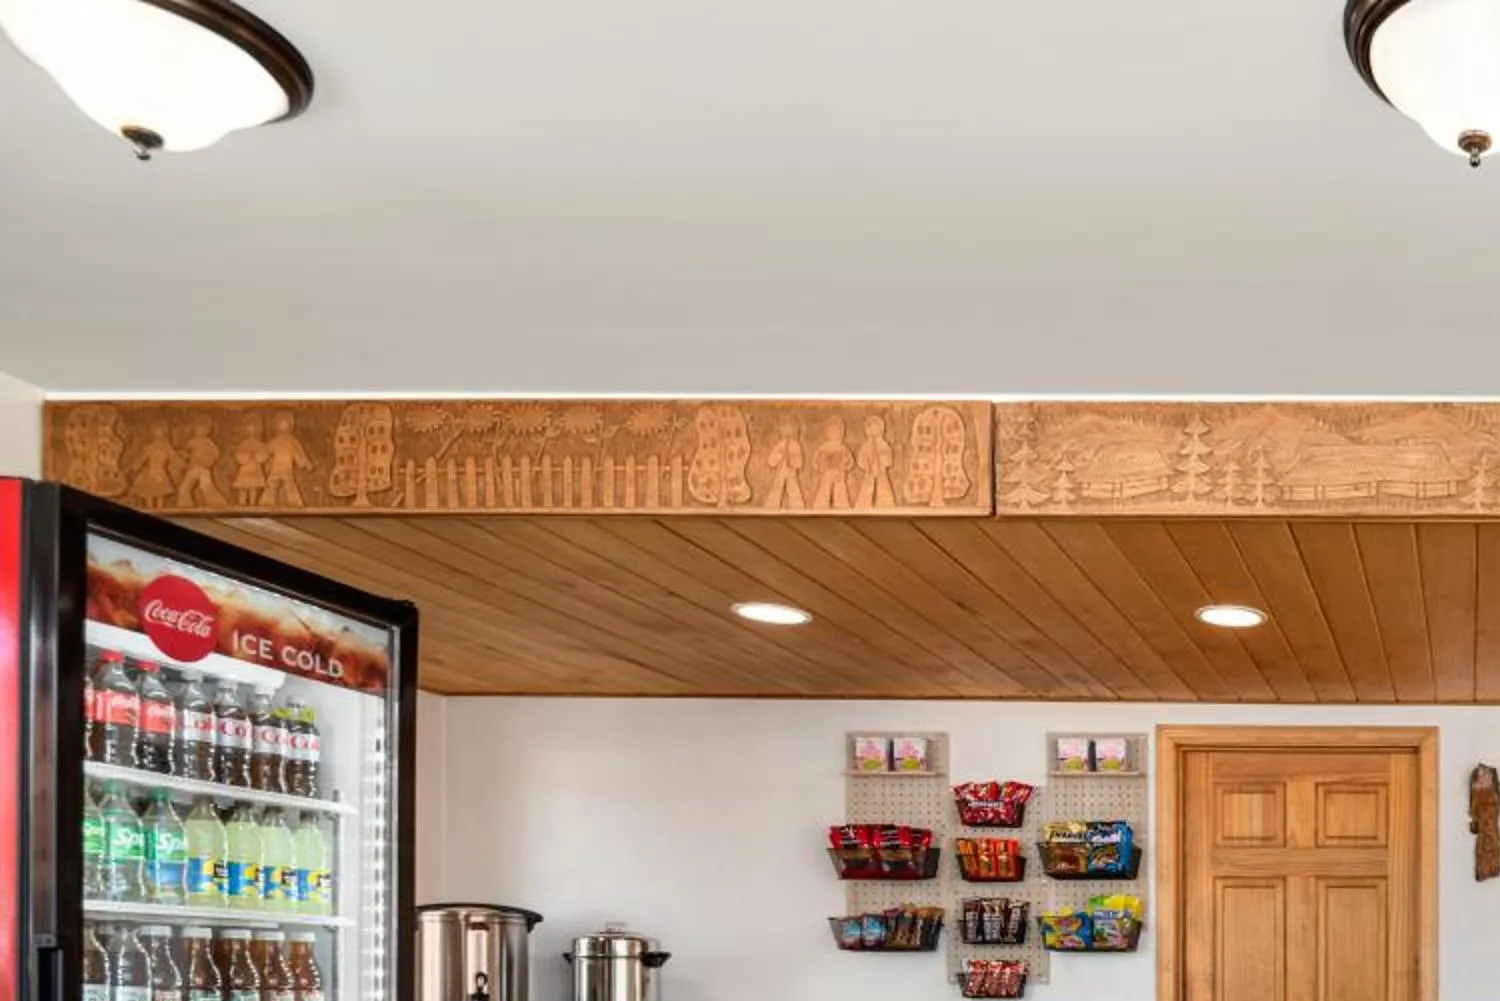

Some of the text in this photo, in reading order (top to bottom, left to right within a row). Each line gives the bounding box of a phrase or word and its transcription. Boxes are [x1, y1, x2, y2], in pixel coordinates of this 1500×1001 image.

[144, 599, 214, 637] Coca-Cola
[231, 630, 344, 678] ICE COLD
